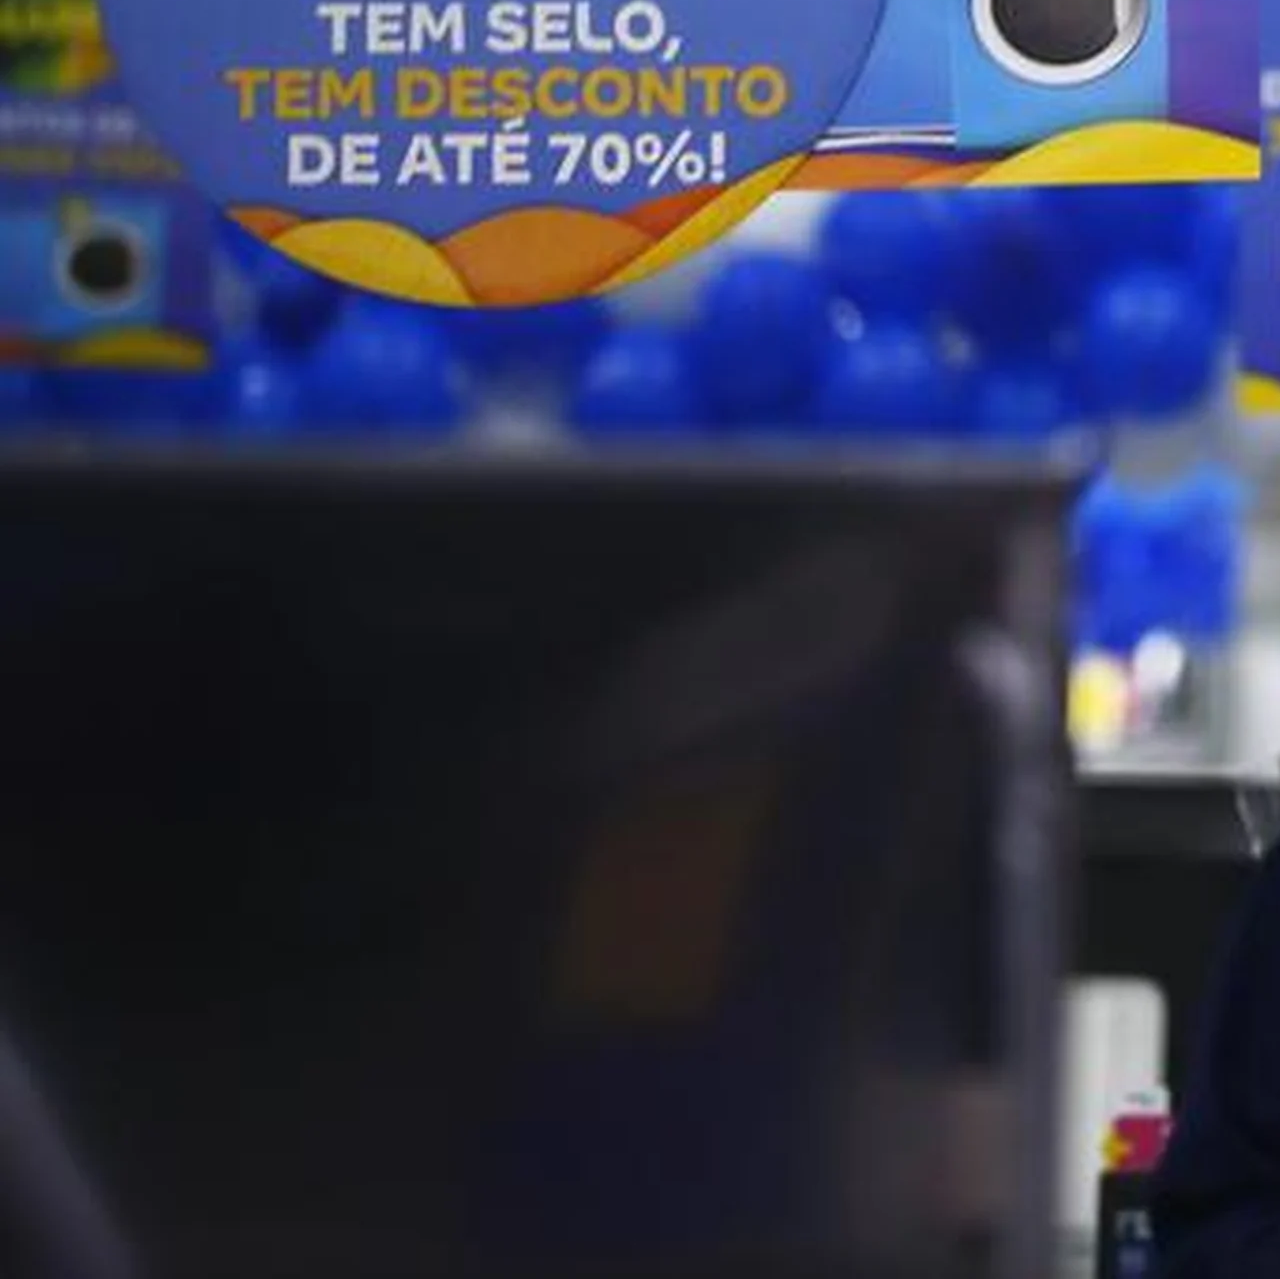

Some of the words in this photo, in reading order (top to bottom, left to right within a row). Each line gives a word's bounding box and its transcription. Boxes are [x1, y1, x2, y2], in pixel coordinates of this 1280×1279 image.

[317, 2, 464, 54] TEM
[486, 0, 682, 62] SELO,
[225, 66, 374, 121] TEM
[397, 65, 788, 118] DESCONTO
[287, 134, 380, 185] DE
[398, 116, 531, 184] ATÉ
[548, 129, 727, 185] 70%!
